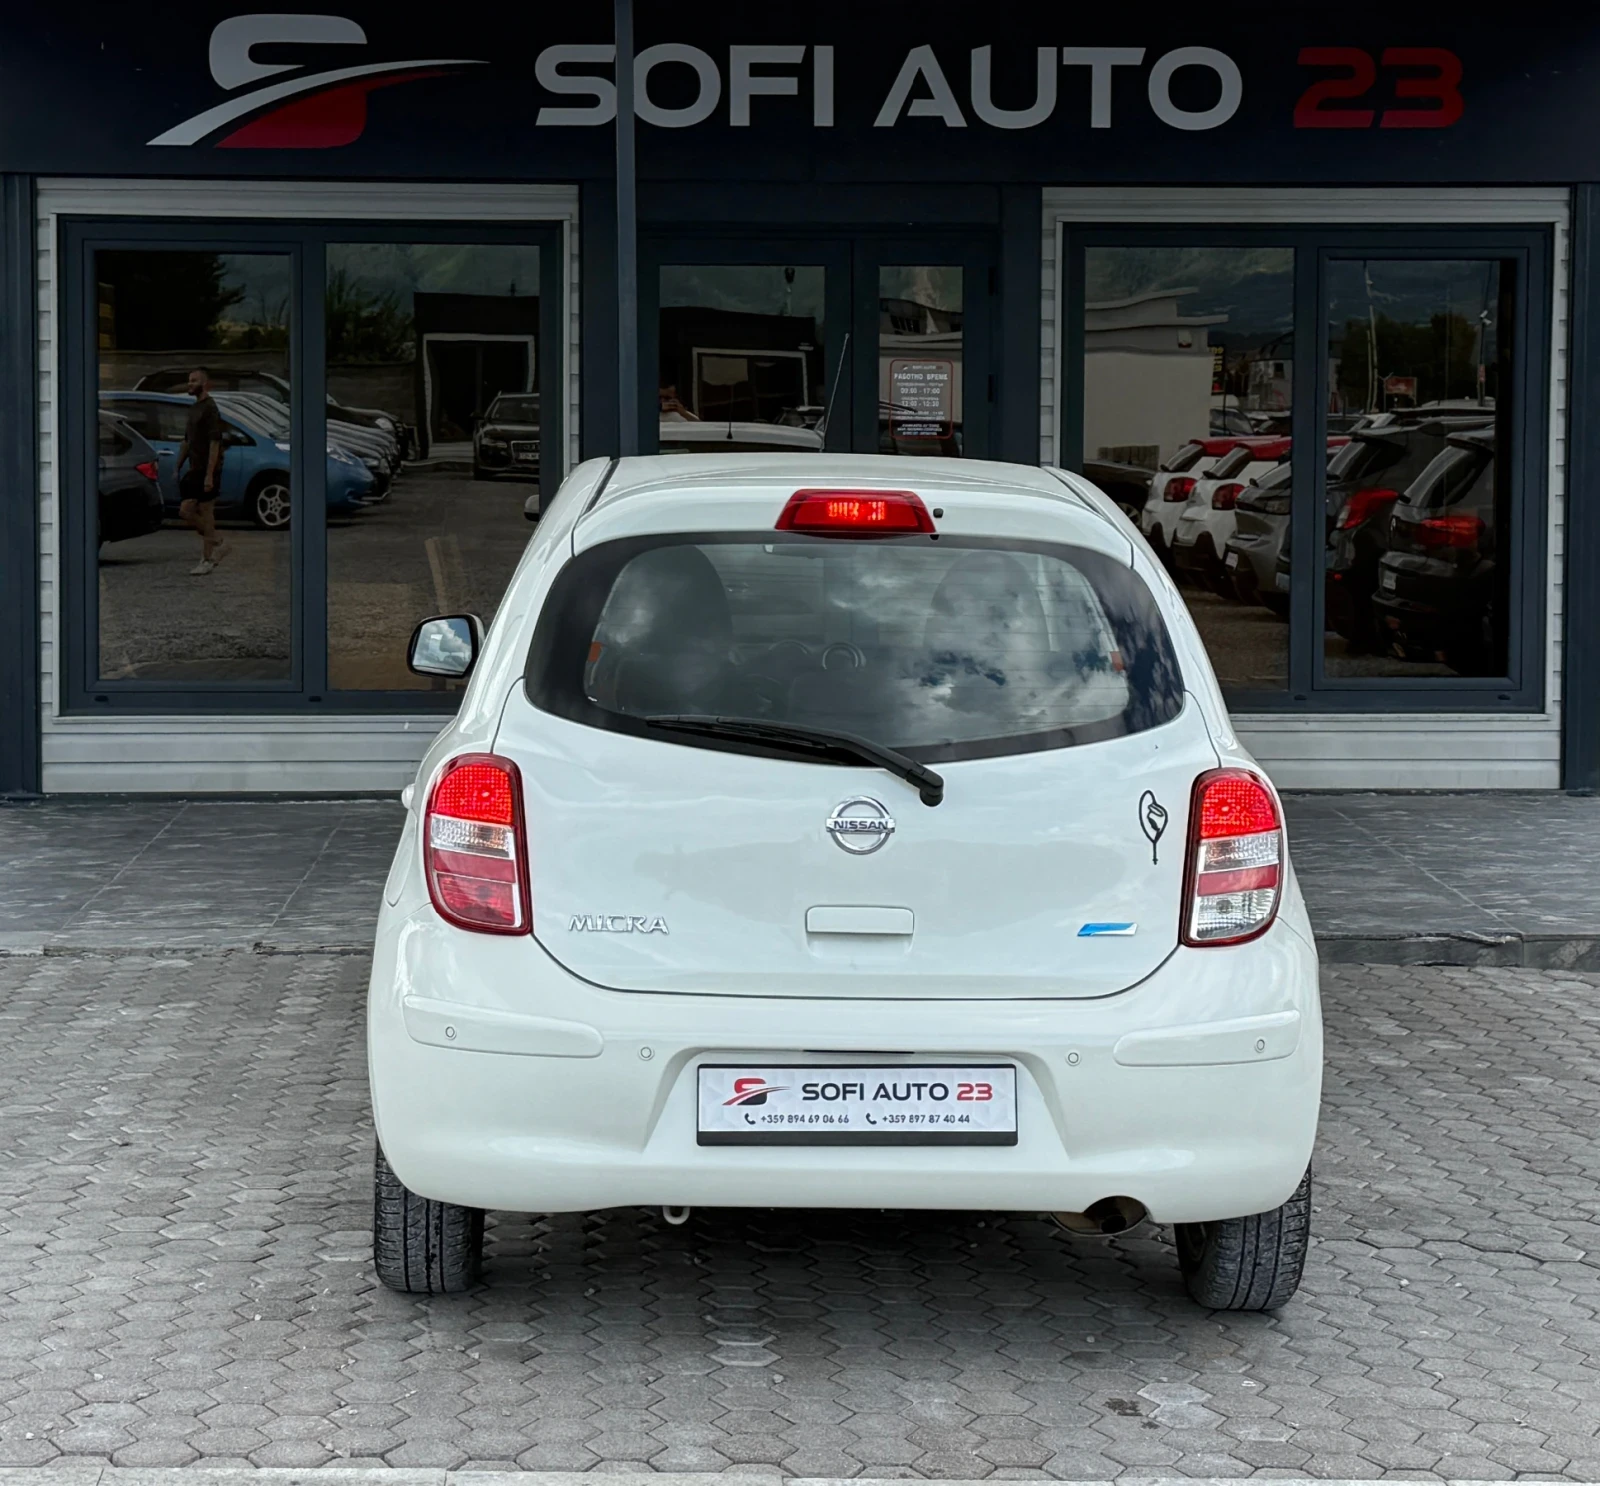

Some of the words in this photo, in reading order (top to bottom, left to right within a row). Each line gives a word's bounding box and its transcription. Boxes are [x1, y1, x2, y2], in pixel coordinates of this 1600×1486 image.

[534, 42, 834, 128] SOFI
[873, 44, 1242, 130] AUTO
[1293, 47, 1464, 128] 23
[834, 820, 888, 829] NISSAN
[568, 914, 669, 935] MICRA
[802, 1083, 865, 1101] SOFI
[872, 1083, 949, 1101] AUTO
[957, 1083, 993, 1101] 23
[761, 1114, 784, 1123] +359
[788, 1114, 805, 1123] 894
[808, 1114, 820, 1123] 69
[823, 1114, 834, 1123] 06
[838, 1114, 849, 1123] 66
[882, 1114, 906, 1123] +359
[909, 1114, 926, 1123] 897
[929, 1114, 940, 1123] 87
[943, 1114, 955, 1123] 40
[958, 1114, 970, 1123] 44
